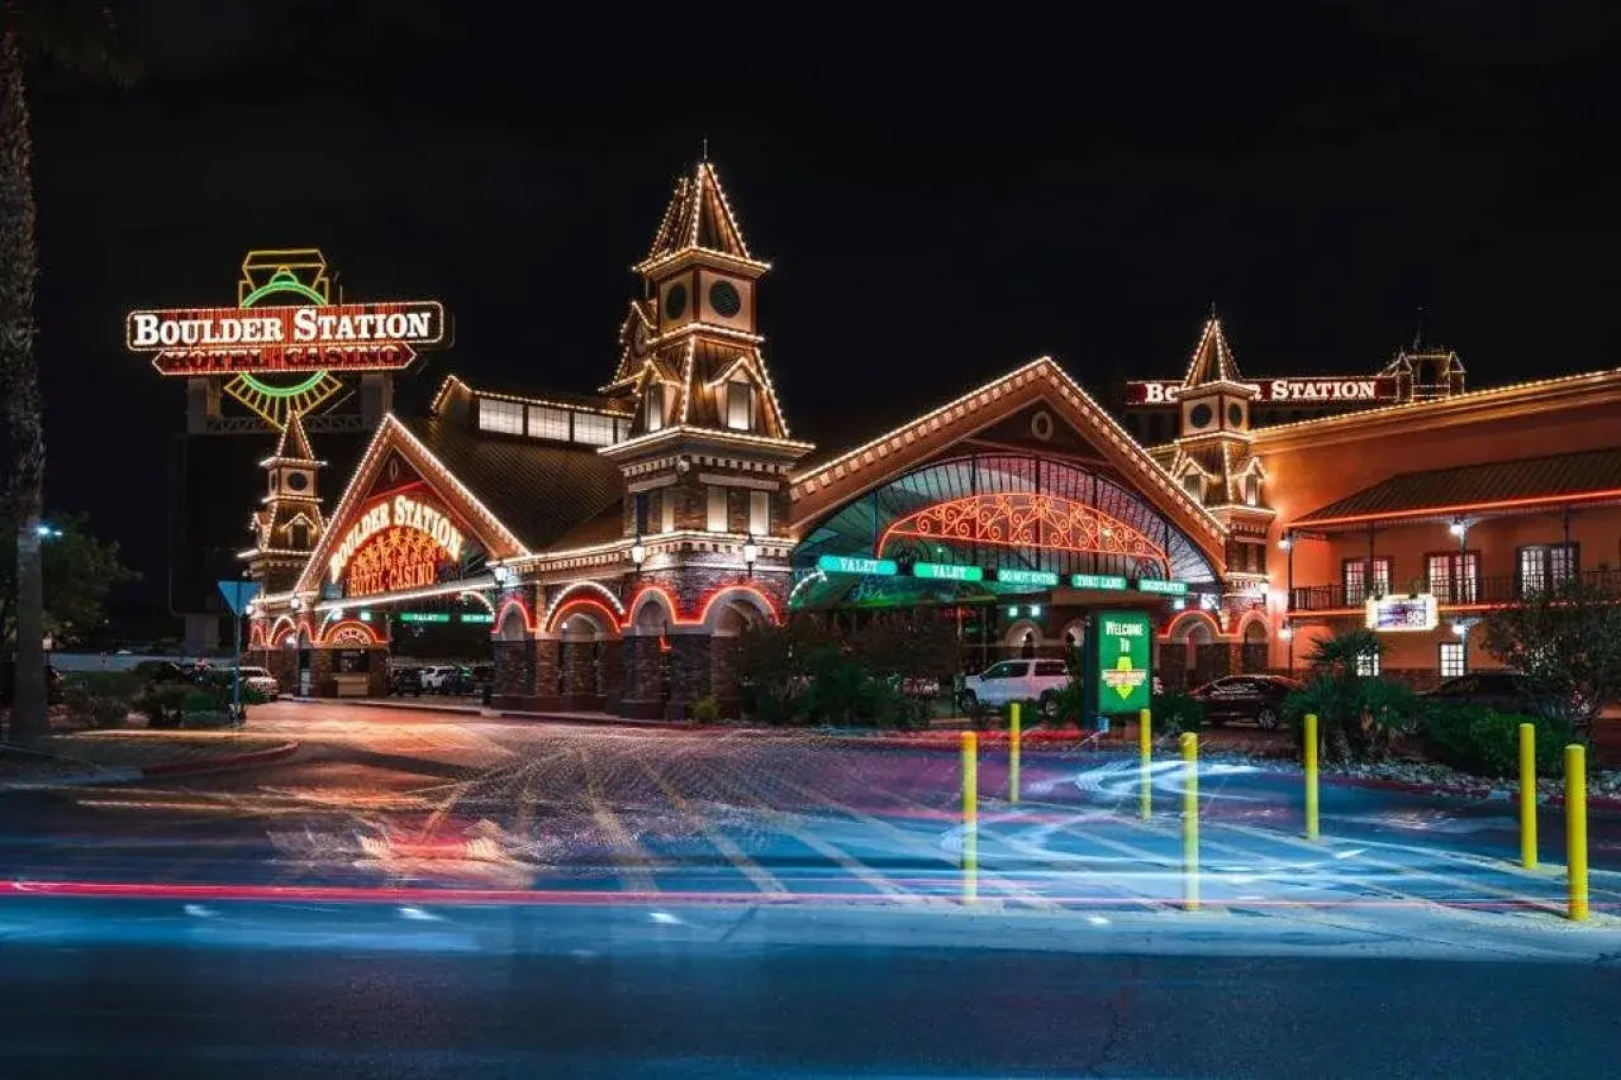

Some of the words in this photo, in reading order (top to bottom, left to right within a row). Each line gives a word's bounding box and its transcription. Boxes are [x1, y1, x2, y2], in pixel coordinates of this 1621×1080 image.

[133, 313, 284, 345] BOULDER
[294, 308, 431, 341] STATION
[164, 350, 268, 368] HOTEL
[284, 346, 399, 367] CASINO
[1270, 380, 1376, 400] STATION
[329, 502, 390, 584] BOULDER
[394, 494, 464, 563] STATION
[840, 558, 878, 573] VALET
[932, 565, 966, 580] VALET
[351, 570, 385, 597] HOTEL
[389, 561, 434, 591] CASINO
[1105, 621, 1143, 636] WELCOME
